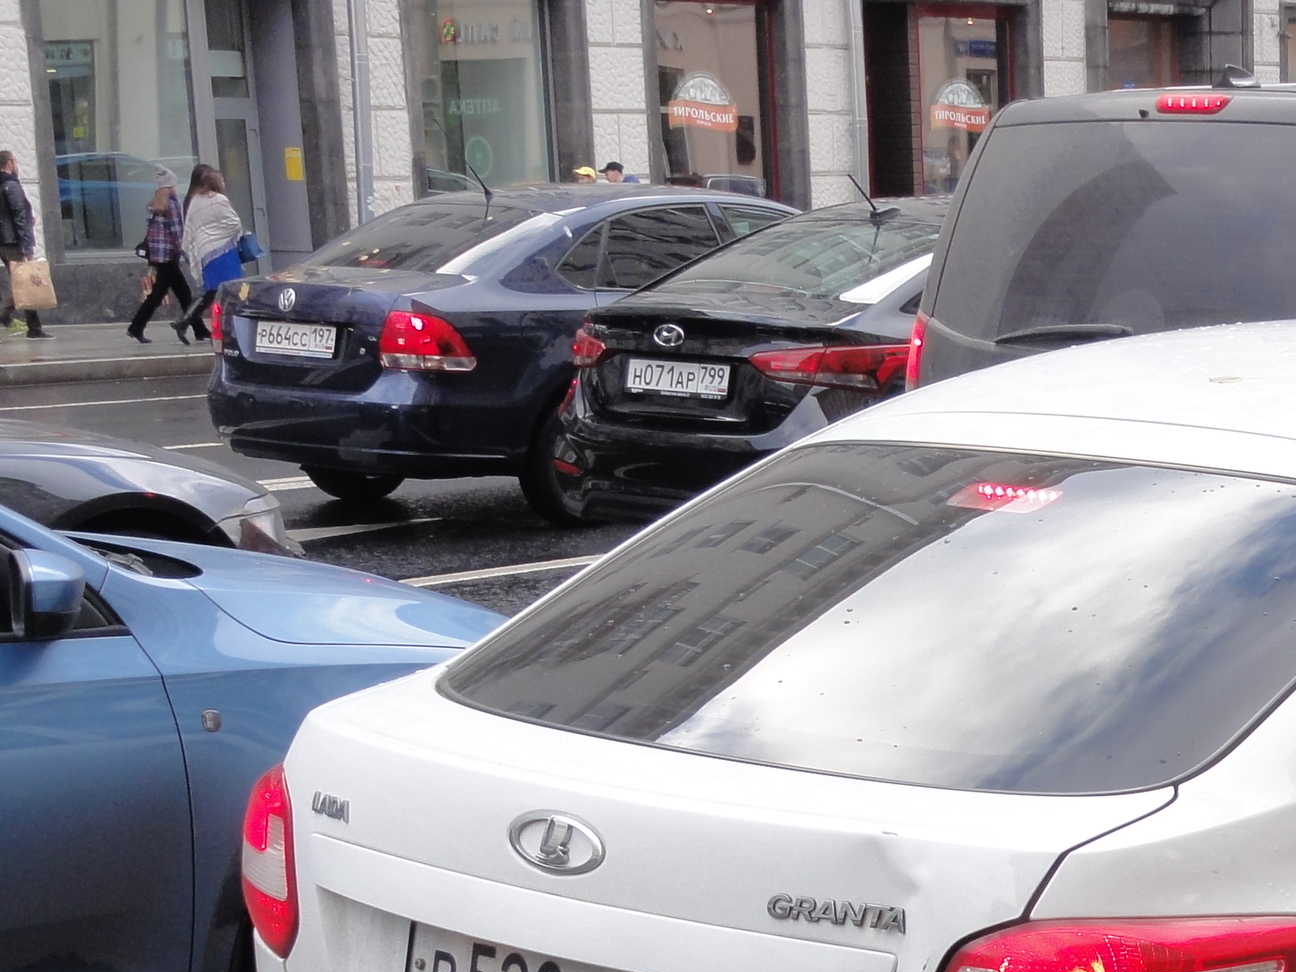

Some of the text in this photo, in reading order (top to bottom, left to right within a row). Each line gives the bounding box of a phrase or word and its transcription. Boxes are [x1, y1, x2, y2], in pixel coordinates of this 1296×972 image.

[673, 106, 734, 124] ТИРОЛЬСКИЕ
[934, 109, 986, 125] ТИРОЛЬСКИЕ
[260, 325, 332, 347] Р664СС 197
[632, 363, 726, 389] Н071АР 799
[311, 790, 350, 825] LADA
[766, 892, 907, 935] GRANTA
